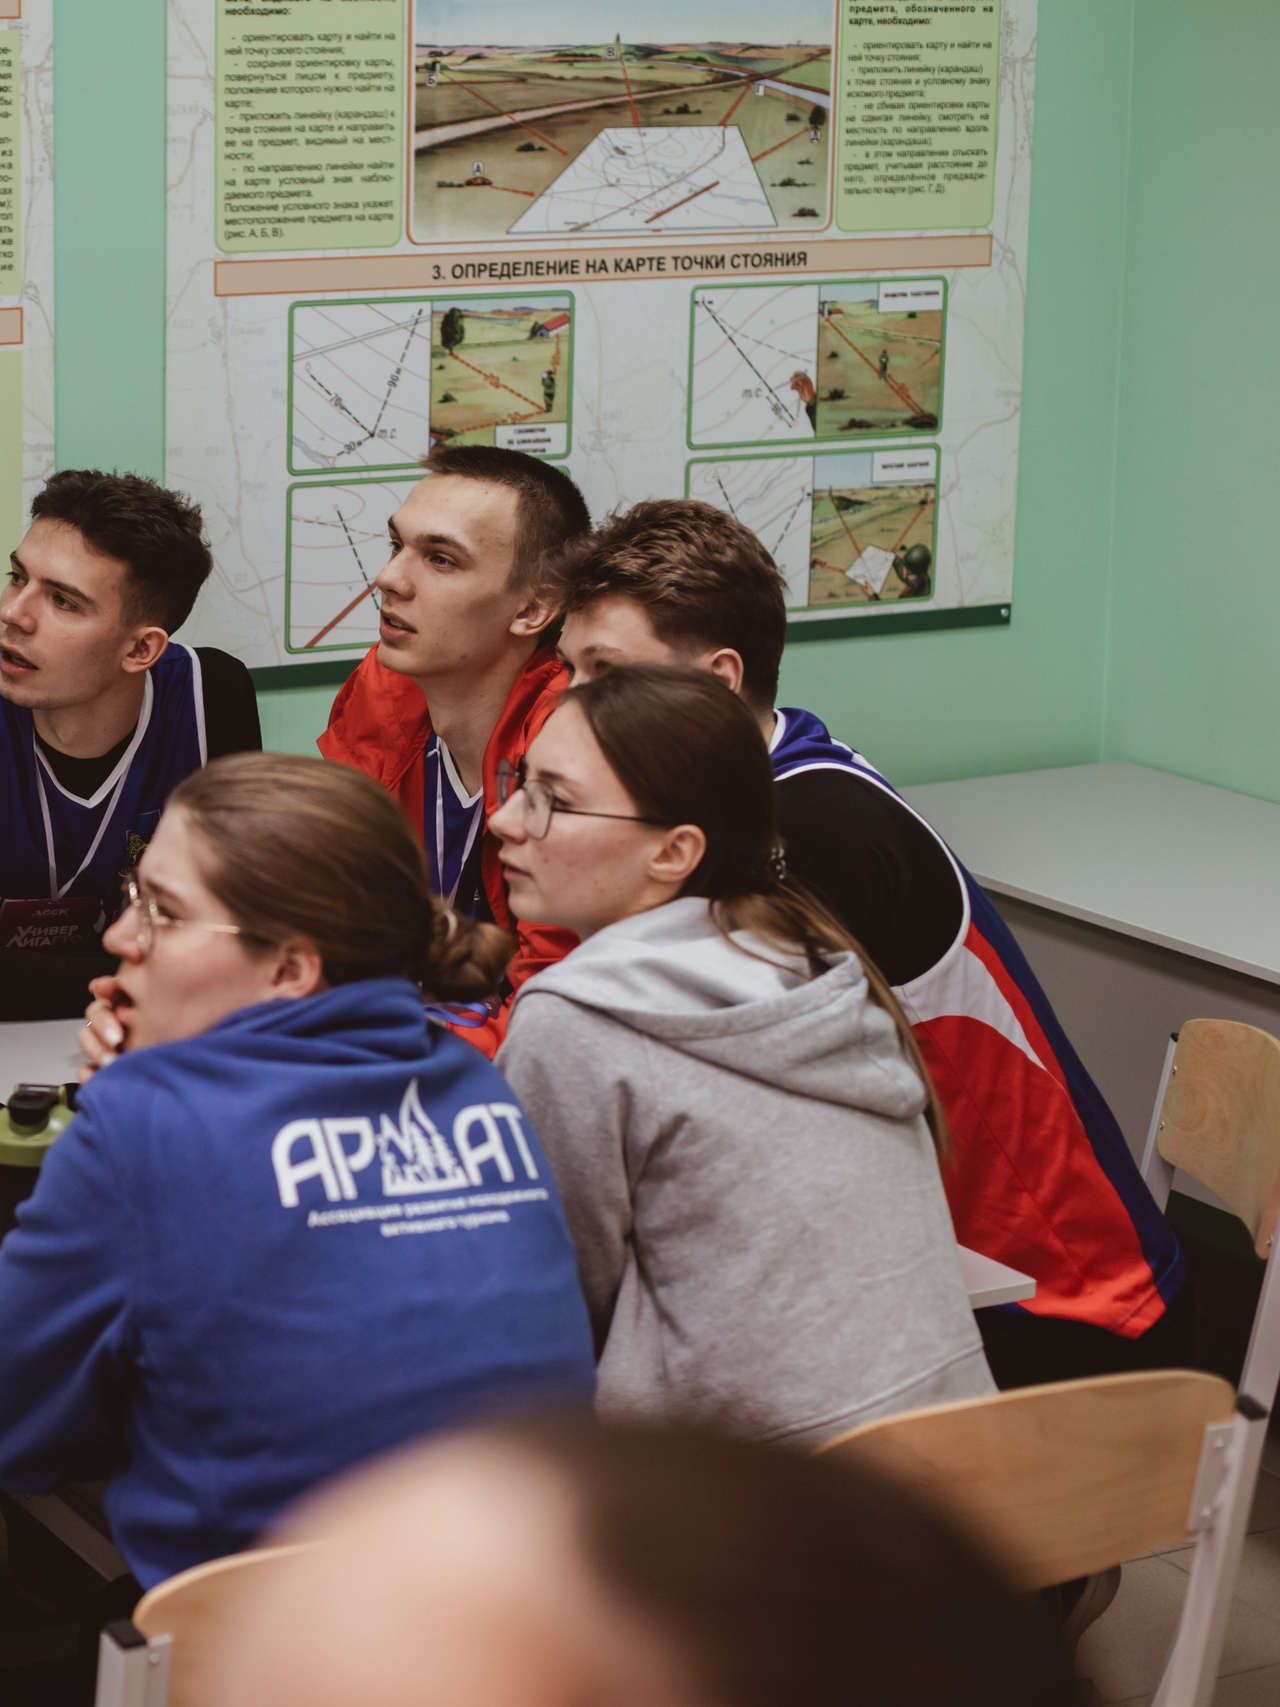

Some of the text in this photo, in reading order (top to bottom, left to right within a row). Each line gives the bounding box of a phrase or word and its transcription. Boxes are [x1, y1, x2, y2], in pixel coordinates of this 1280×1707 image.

[432, 250, 807, 280] 3. ОПРЕДЕЛЕНИЕ НА КАРТЕ ТОЧКИ СТОЯНИЯ
